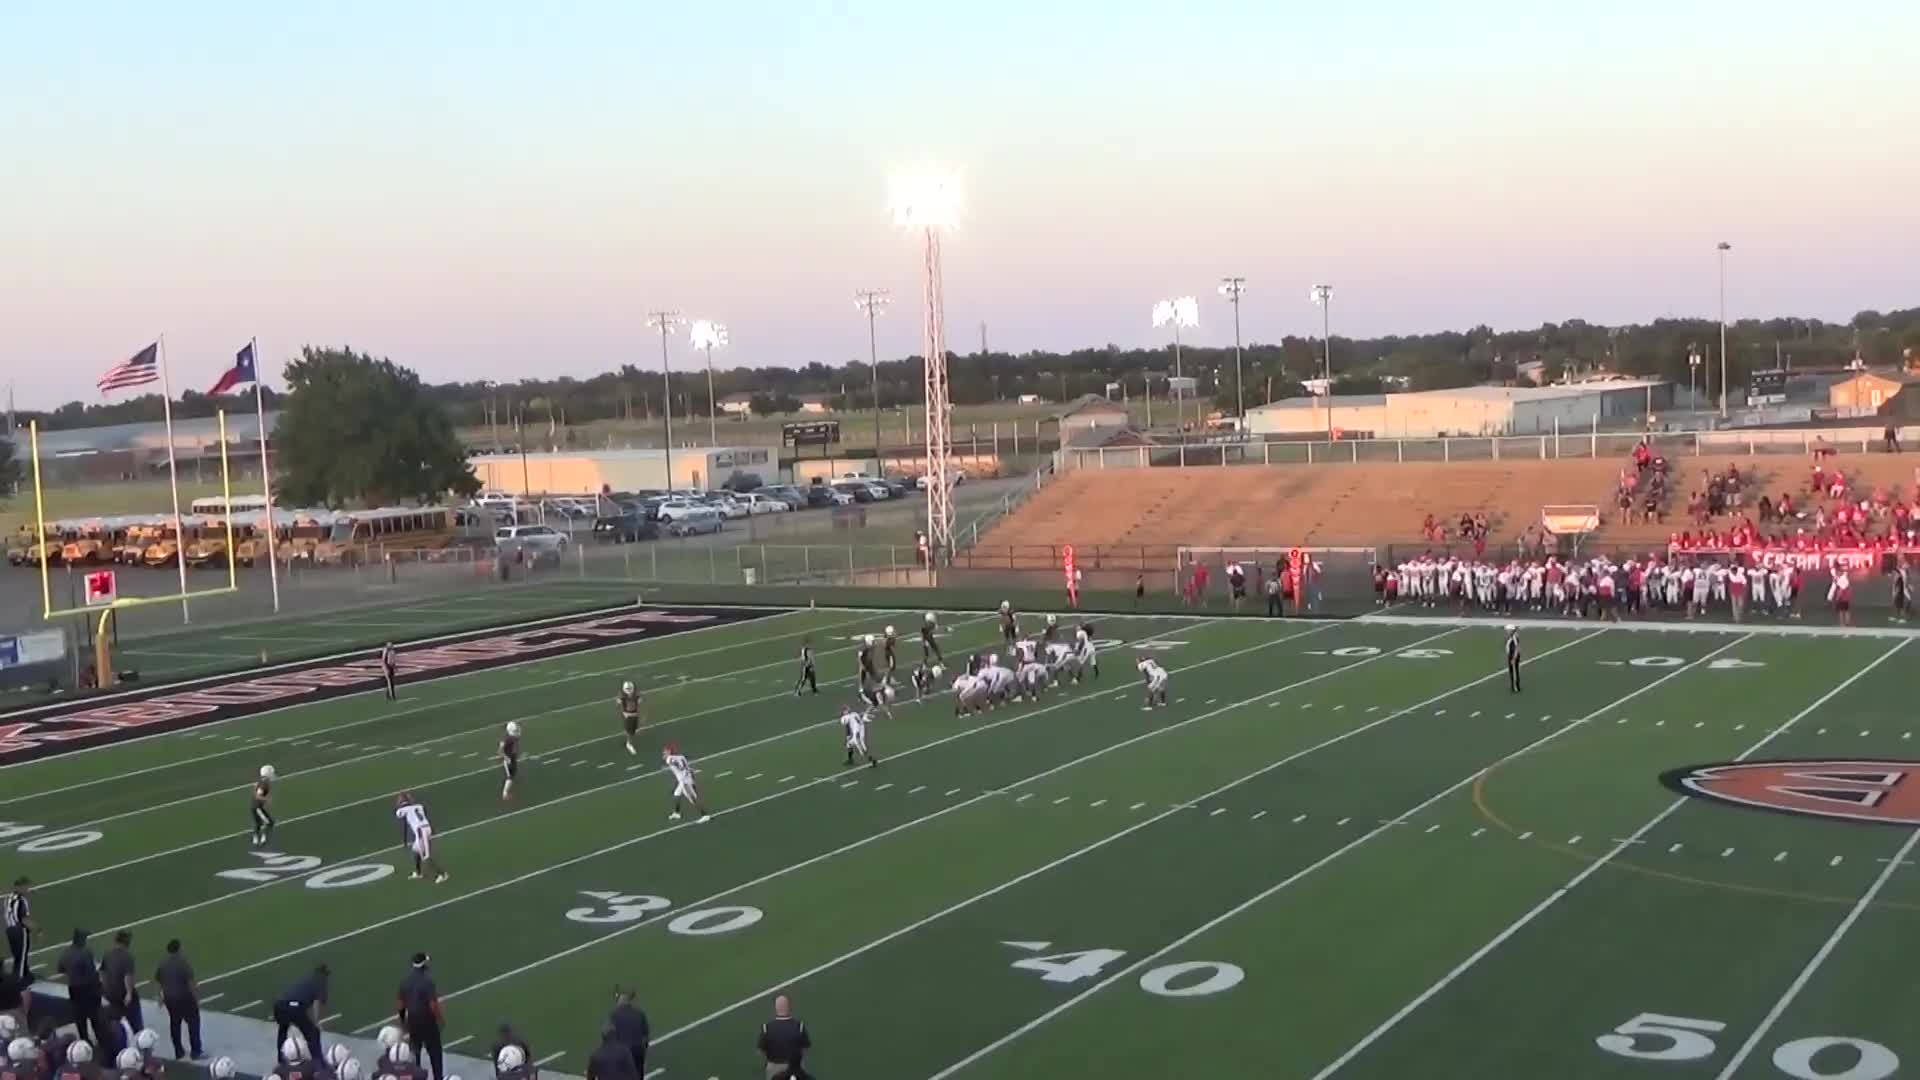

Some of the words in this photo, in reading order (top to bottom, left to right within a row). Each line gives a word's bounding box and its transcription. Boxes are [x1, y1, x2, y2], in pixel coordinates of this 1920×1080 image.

[215, 853, 395, 889] 20
[566, 894, 764, 935] 30
[1011, 948, 1245, 997] 40
[1595, 1012, 1900, 1080] 50
